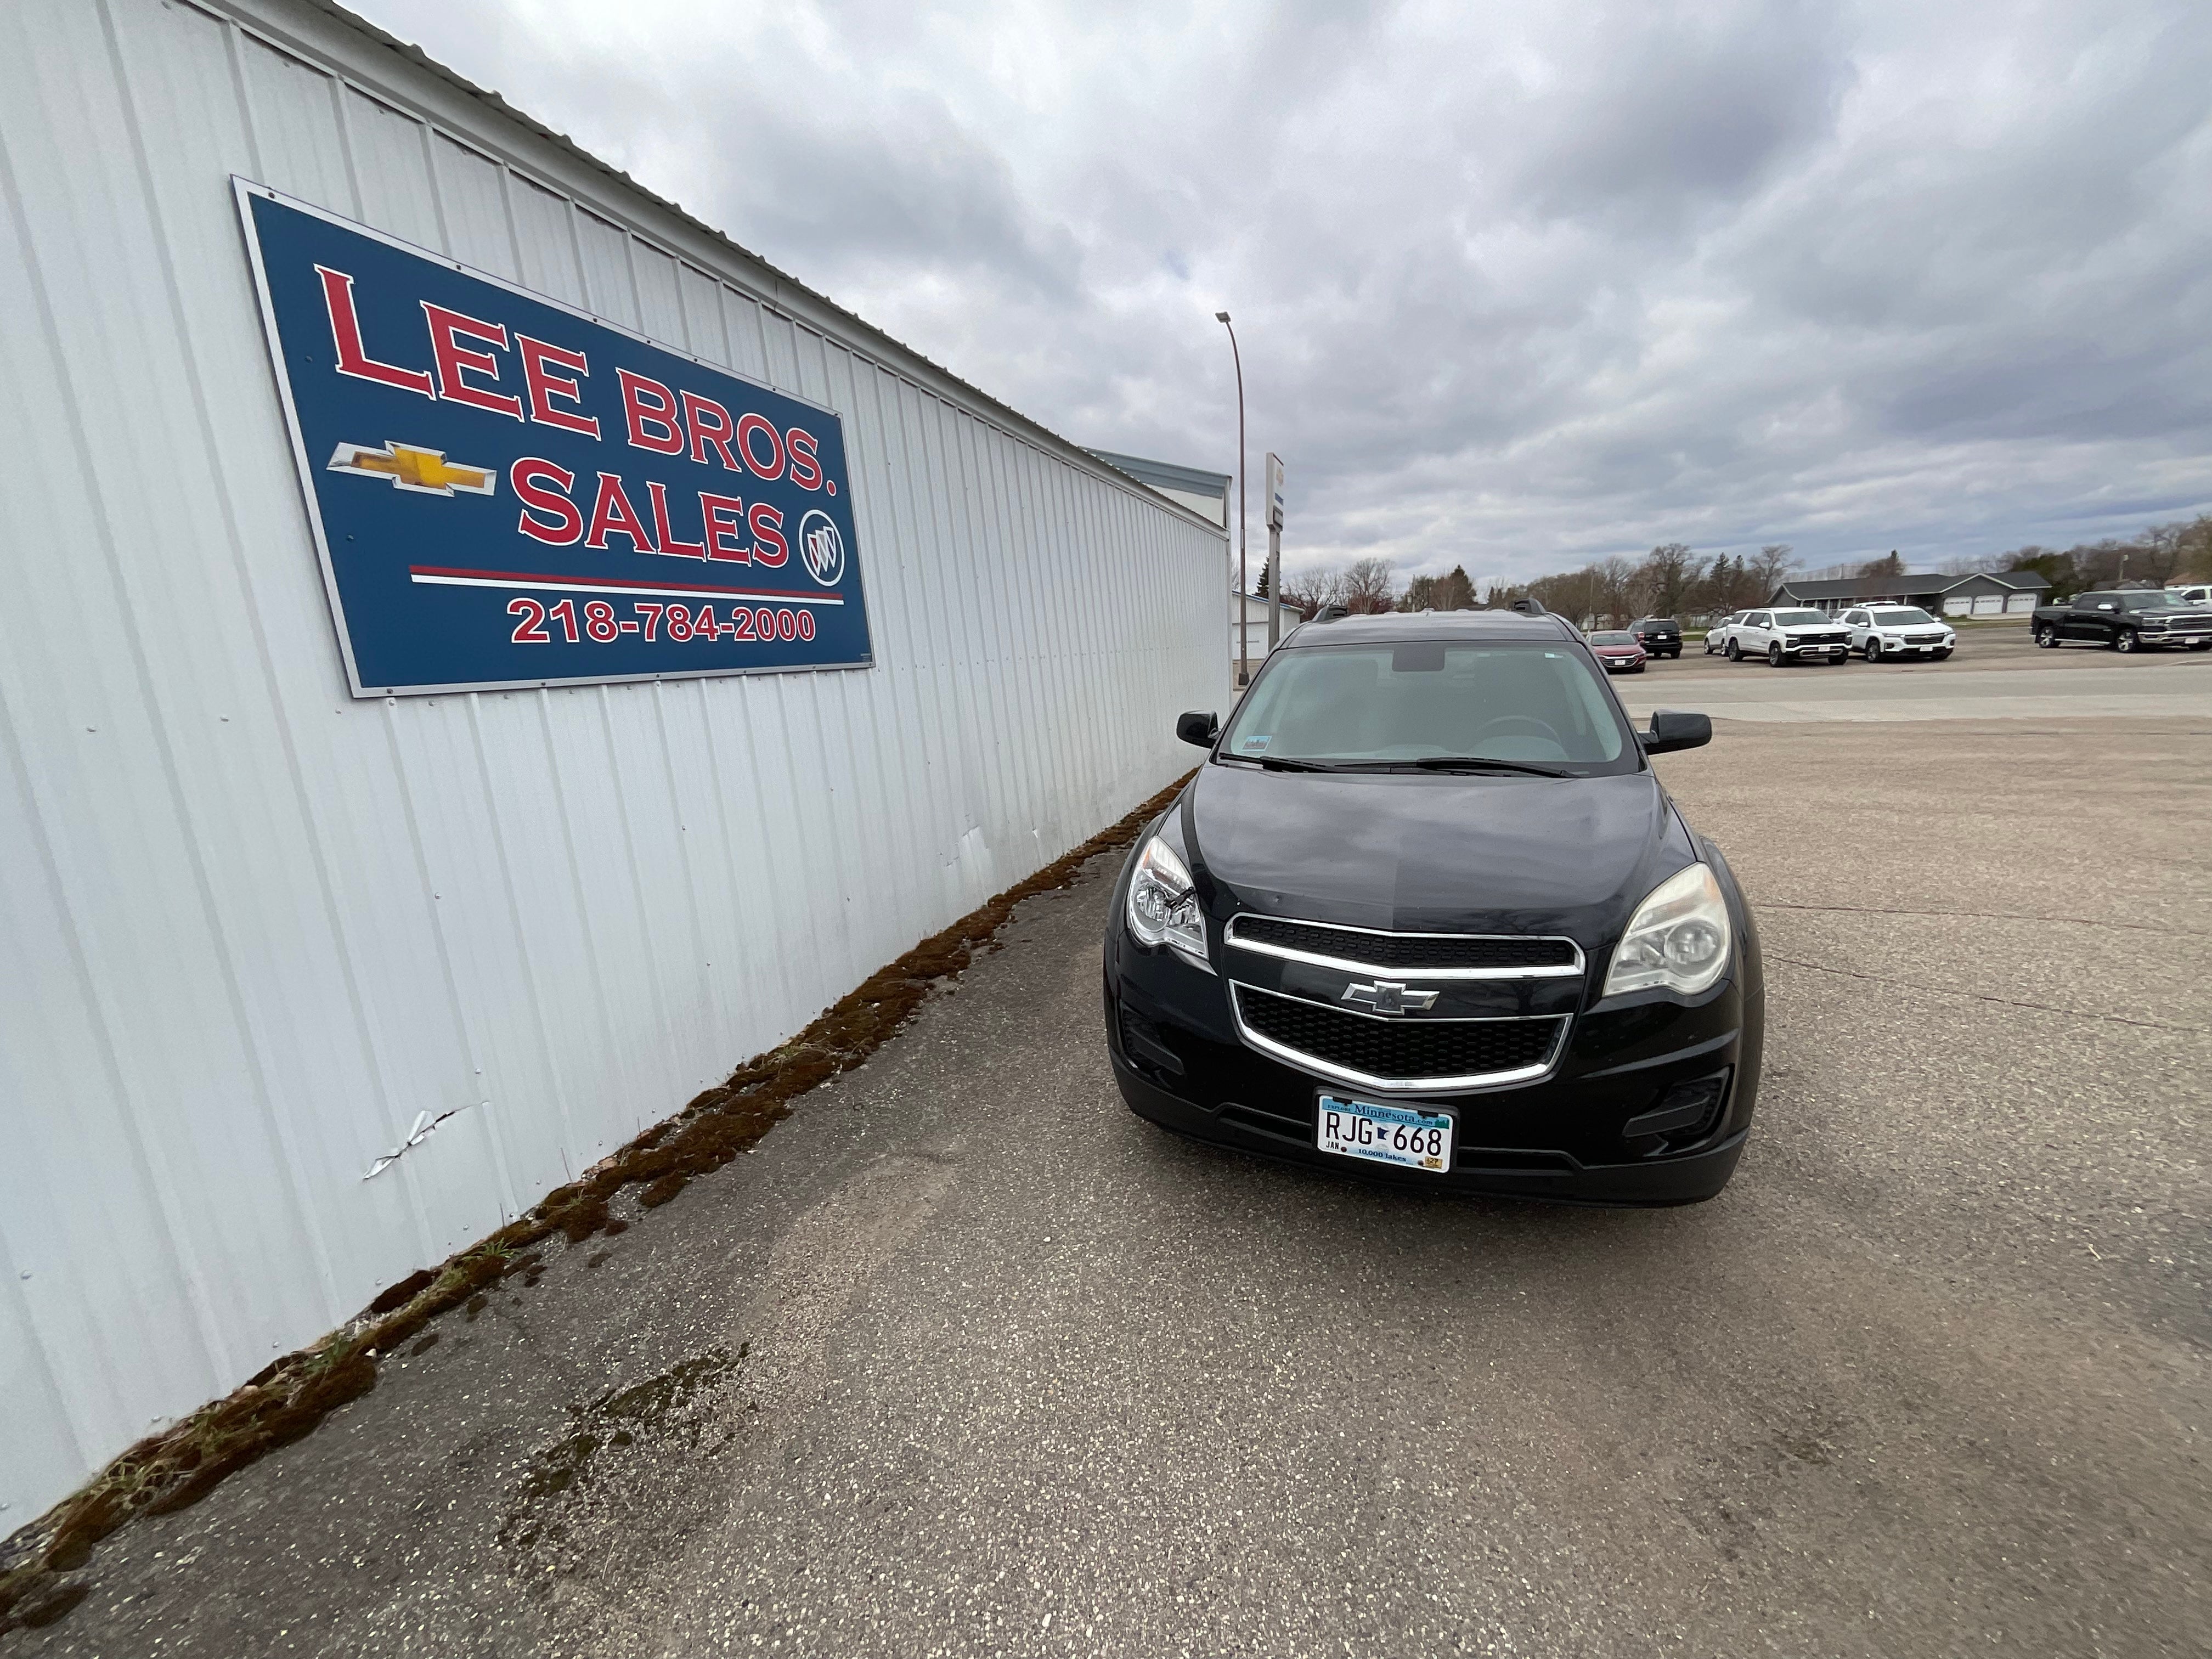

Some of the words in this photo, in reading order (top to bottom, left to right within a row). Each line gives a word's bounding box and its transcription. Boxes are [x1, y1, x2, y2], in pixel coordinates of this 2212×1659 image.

[313, 263, 601, 442] LEE
[616, 367, 837, 497] BROS.
[510, 456, 789, 568] SALES
[506, 597, 816, 644] 218-784-2000
[1326, 1111, 1373, 1145] RJG
[1393, 1124, 1442, 1156] 668
[1326, 1141, 1339, 1150] JAN
[1358, 1149, 1384, 1158] 10,000
[1386, 1153, 1406, 1162] lakes
